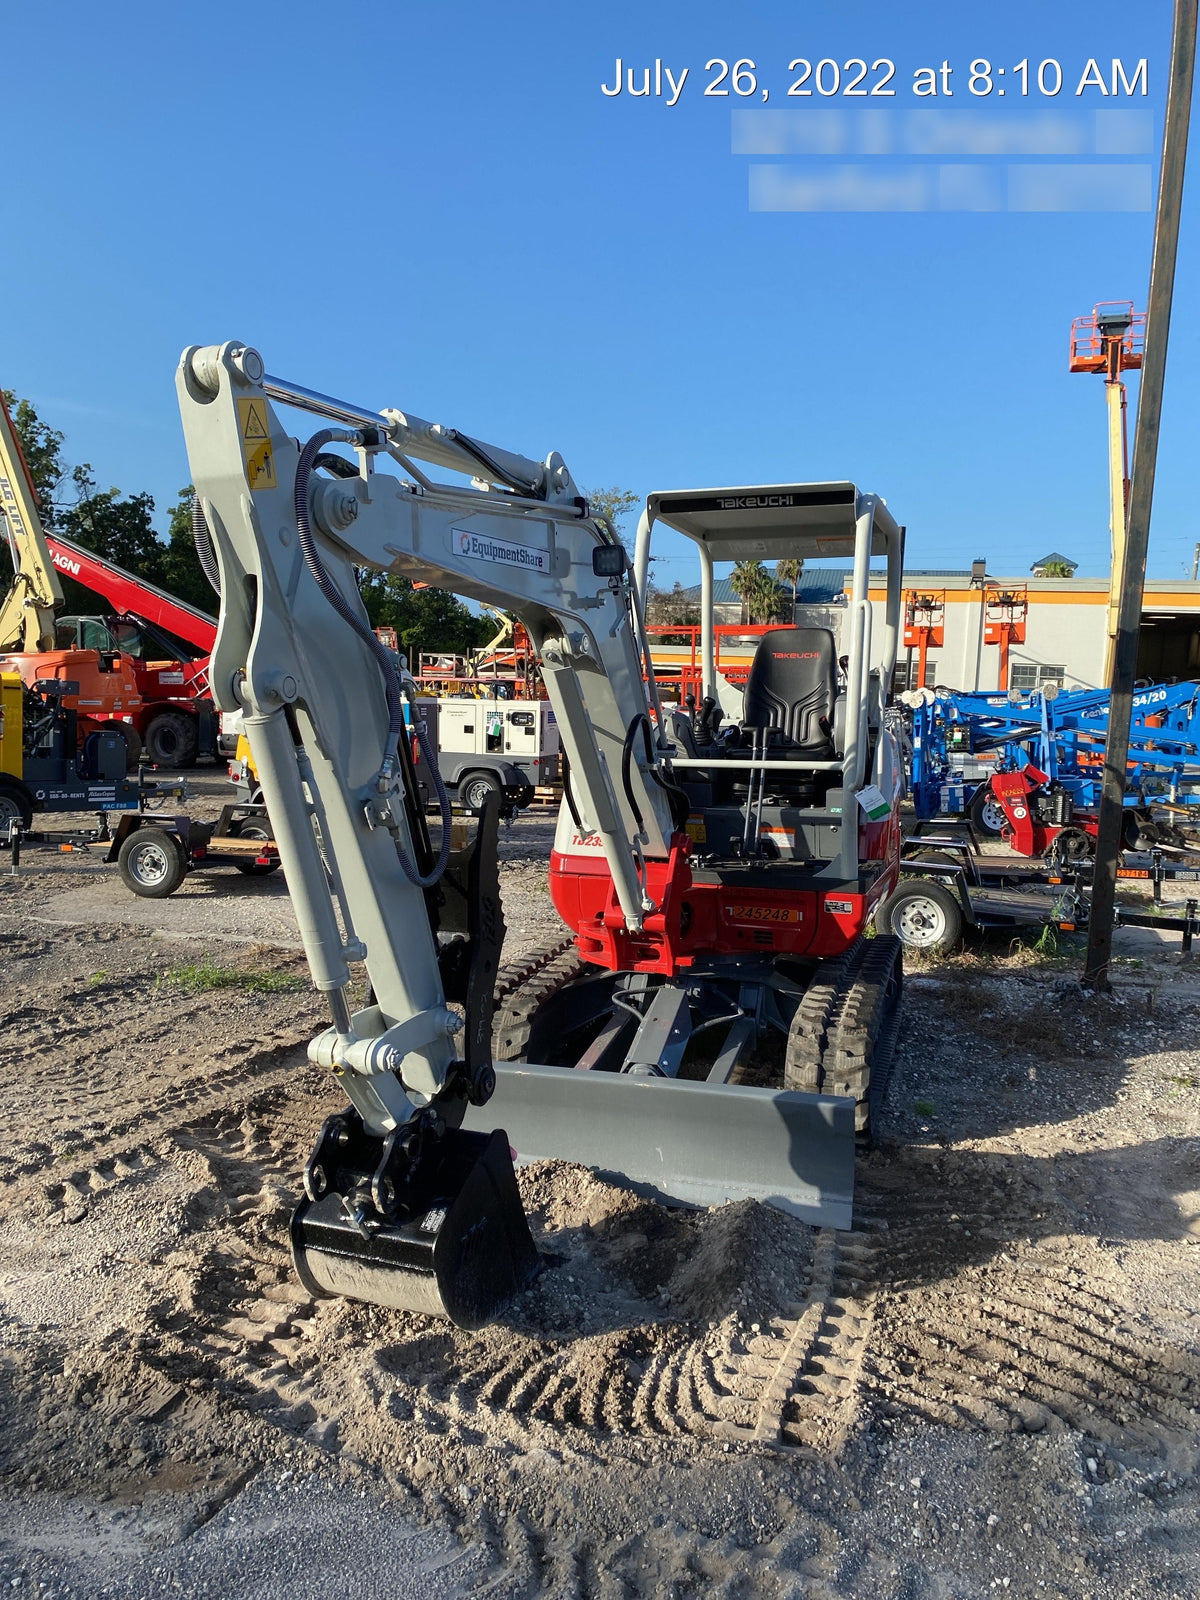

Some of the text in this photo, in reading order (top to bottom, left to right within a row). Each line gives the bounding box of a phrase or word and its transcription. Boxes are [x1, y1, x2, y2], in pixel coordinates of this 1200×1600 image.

[716, 495, 794, 509] TAKEUCHI
[8, 505, 26, 536] LIFT
[49, 549, 81, 576] AGNI
[471, 537, 543, 567] EquipmentShare
[772, 651, 820, 659] TAKEUCHI
[736, 906, 790, 921] 245248
